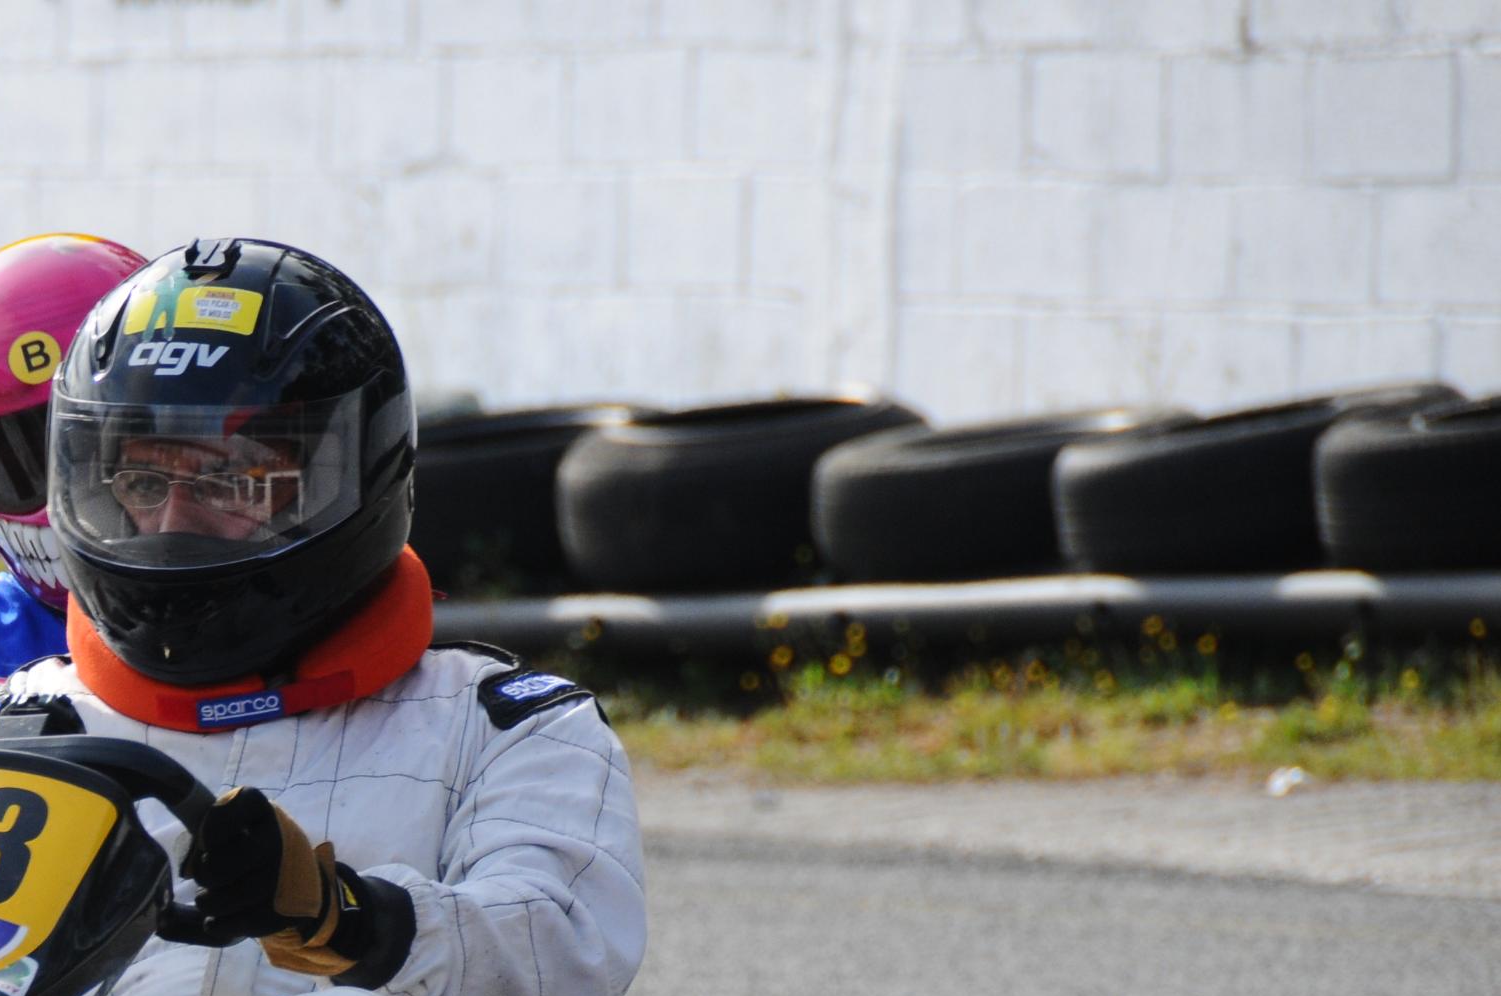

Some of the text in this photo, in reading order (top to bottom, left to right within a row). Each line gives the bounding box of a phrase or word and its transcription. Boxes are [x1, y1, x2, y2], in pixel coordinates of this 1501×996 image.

[21, 340, 51, 372] B
[127, 341, 230, 376] agv
[201, 696, 279, 721] sparco
